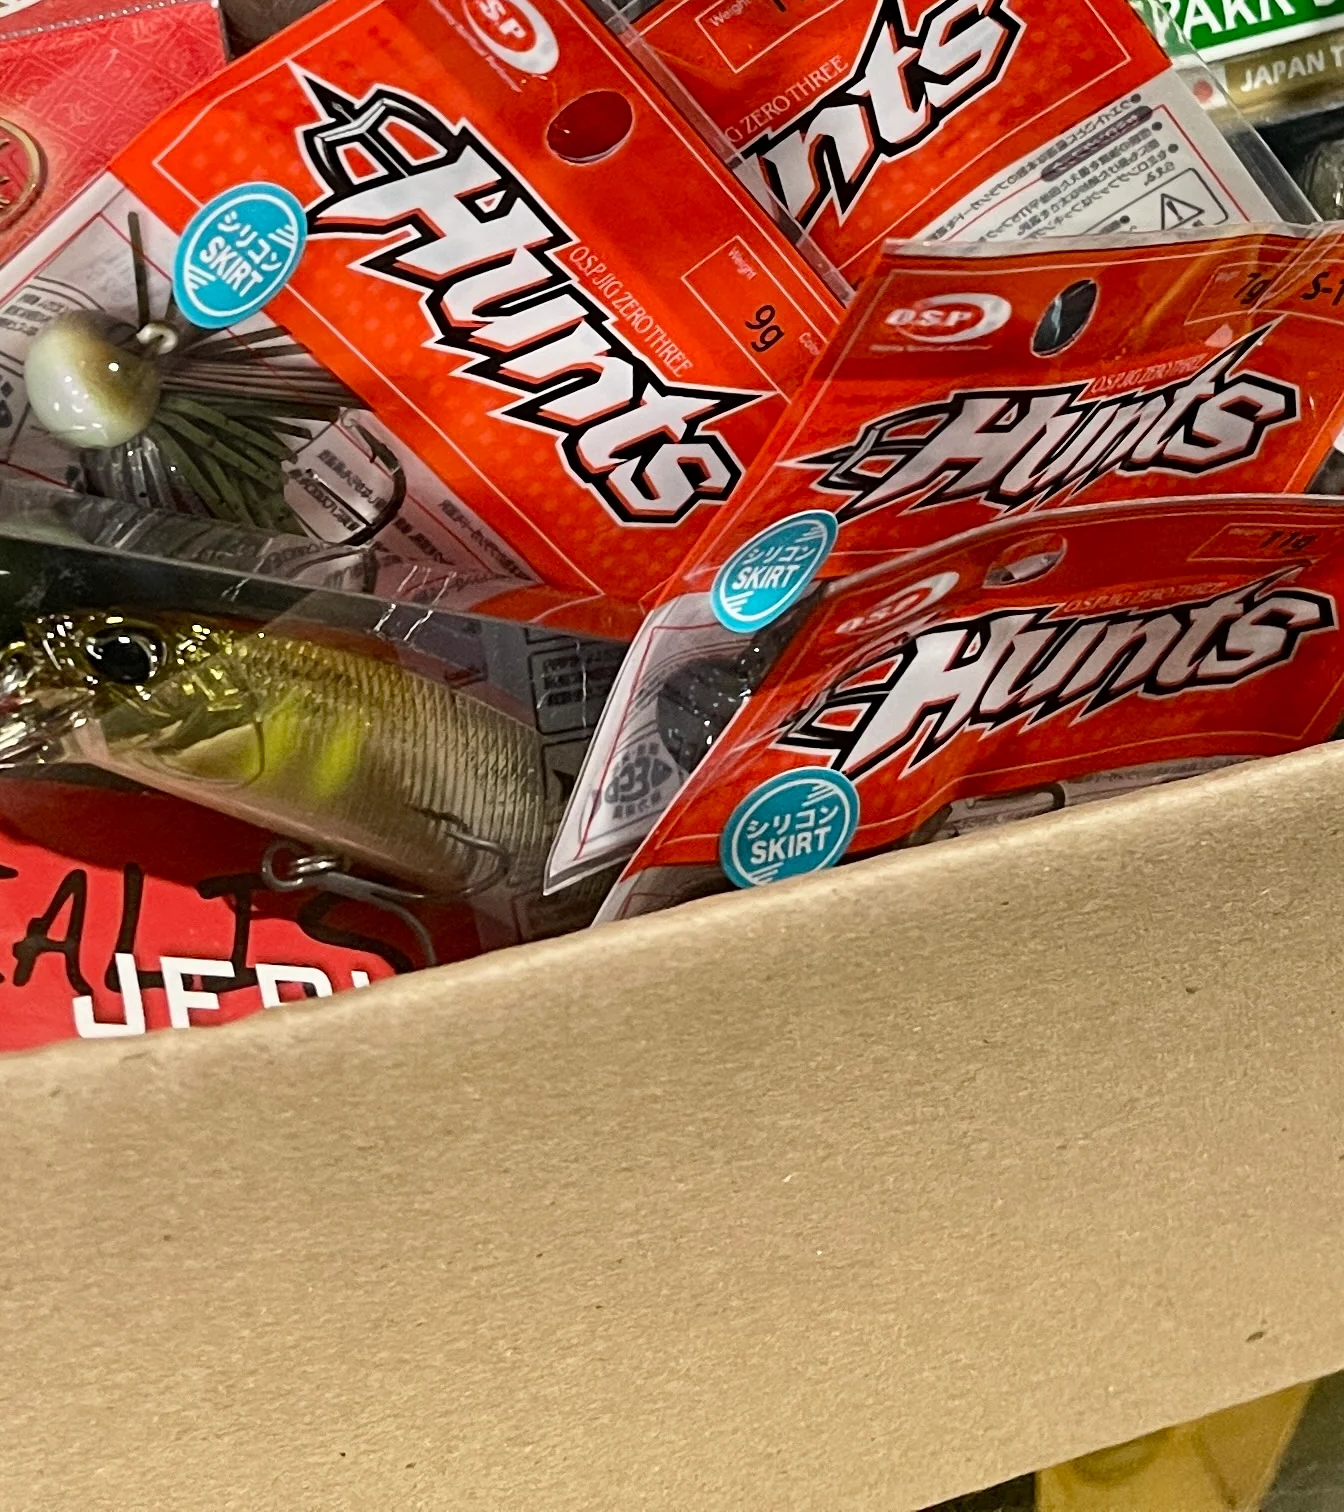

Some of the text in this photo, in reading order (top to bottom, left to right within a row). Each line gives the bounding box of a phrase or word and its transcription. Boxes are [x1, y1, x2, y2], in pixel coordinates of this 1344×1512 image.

[1238, 48, 1328, 93] JAPAN
[216, 207, 286, 274] シリコン
[198, 234, 264, 301] SKIRT
[296, 88, 774, 528] Hunts
[743, 303, 787, 353] 9g
[831, 325, 1300, 519] Hunts
[734, 564, 801, 592] SKIRT
[743, 540, 813, 567] シリコン
[846, 565, 1335, 774] Hunts
[746, 804, 837, 842] シリコン
[750, 828, 831, 861] SKIRT
